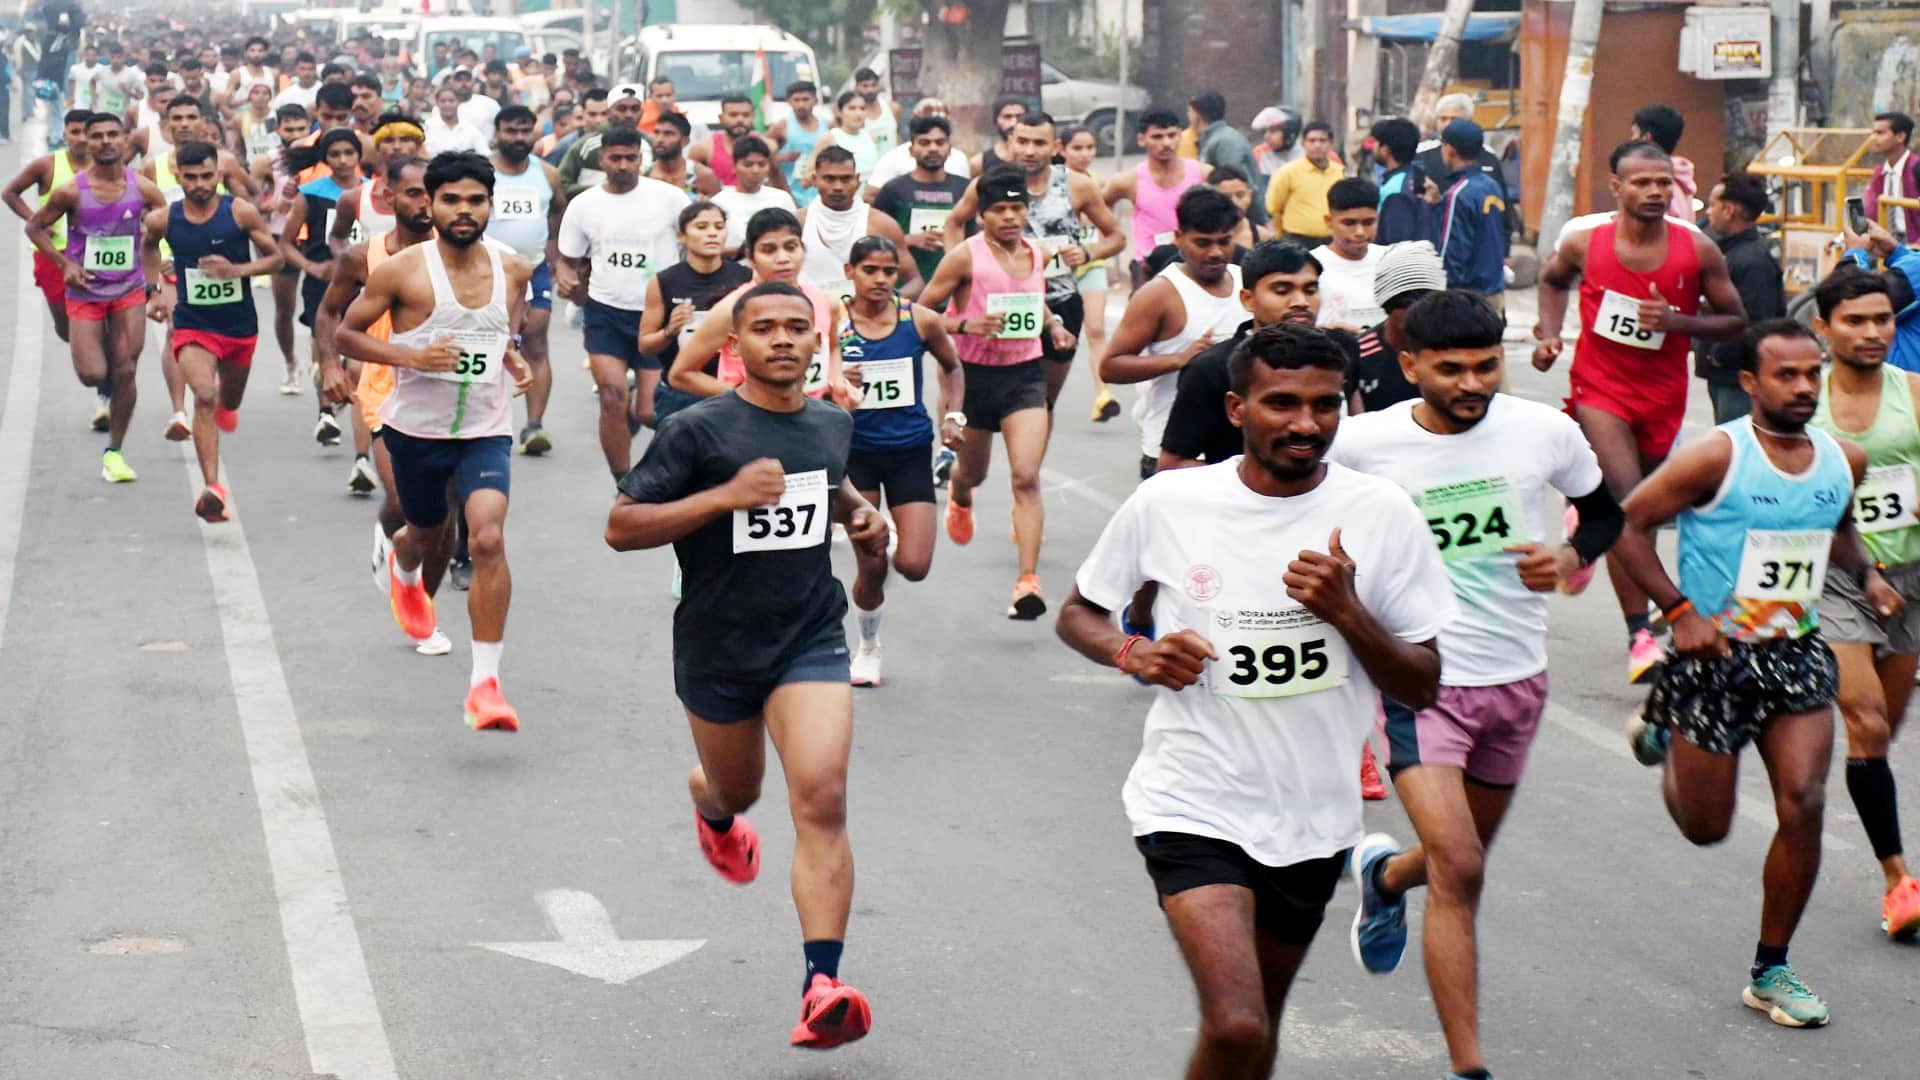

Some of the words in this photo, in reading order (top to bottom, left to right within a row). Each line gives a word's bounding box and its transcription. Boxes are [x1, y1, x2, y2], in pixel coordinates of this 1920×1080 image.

[502, 200, 533, 214] 263
[93, 251, 126, 266] 108
[607, 252, 647, 269] 482
[194, 282, 235, 300] 205
[1008, 312, 1036, 331] 96
[456, 352, 487, 375] 65
[1857, 493, 1903, 522] 53
[748, 504, 816, 539] 537
[1427, 506, 1511, 551] 524
[1758, 561, 1813, 589] 371
[1266, 608, 1309, 617] MARATHO
[1228, 638, 1328, 686] 395
